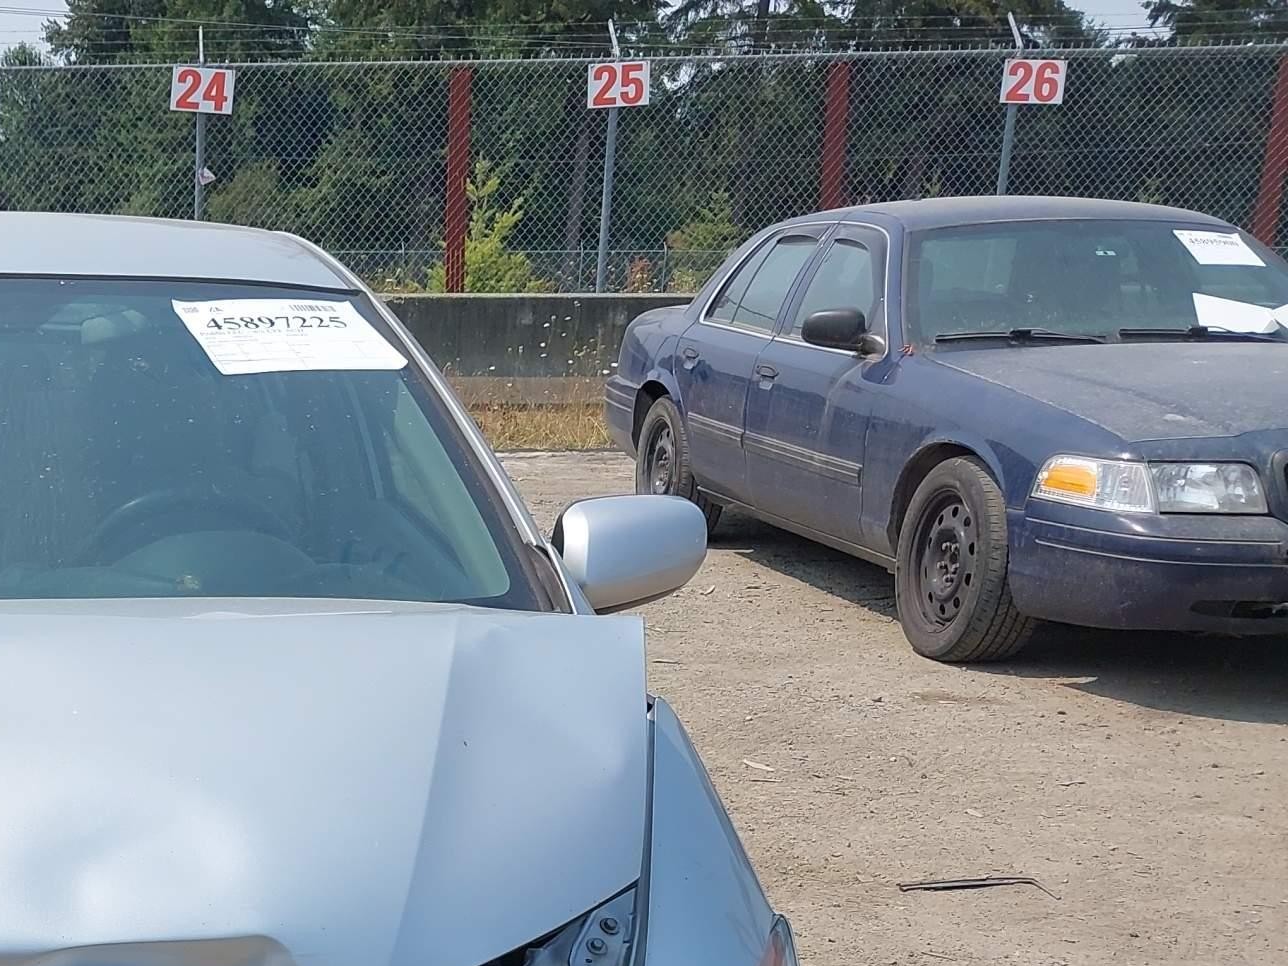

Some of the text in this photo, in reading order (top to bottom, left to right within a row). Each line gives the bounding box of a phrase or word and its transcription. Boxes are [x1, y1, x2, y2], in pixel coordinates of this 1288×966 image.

[176, 69, 228, 111] 24
[593, 64, 643, 106] 25
[1005, 61, 1060, 102] 26
[206, 315, 348, 331] 45897225
